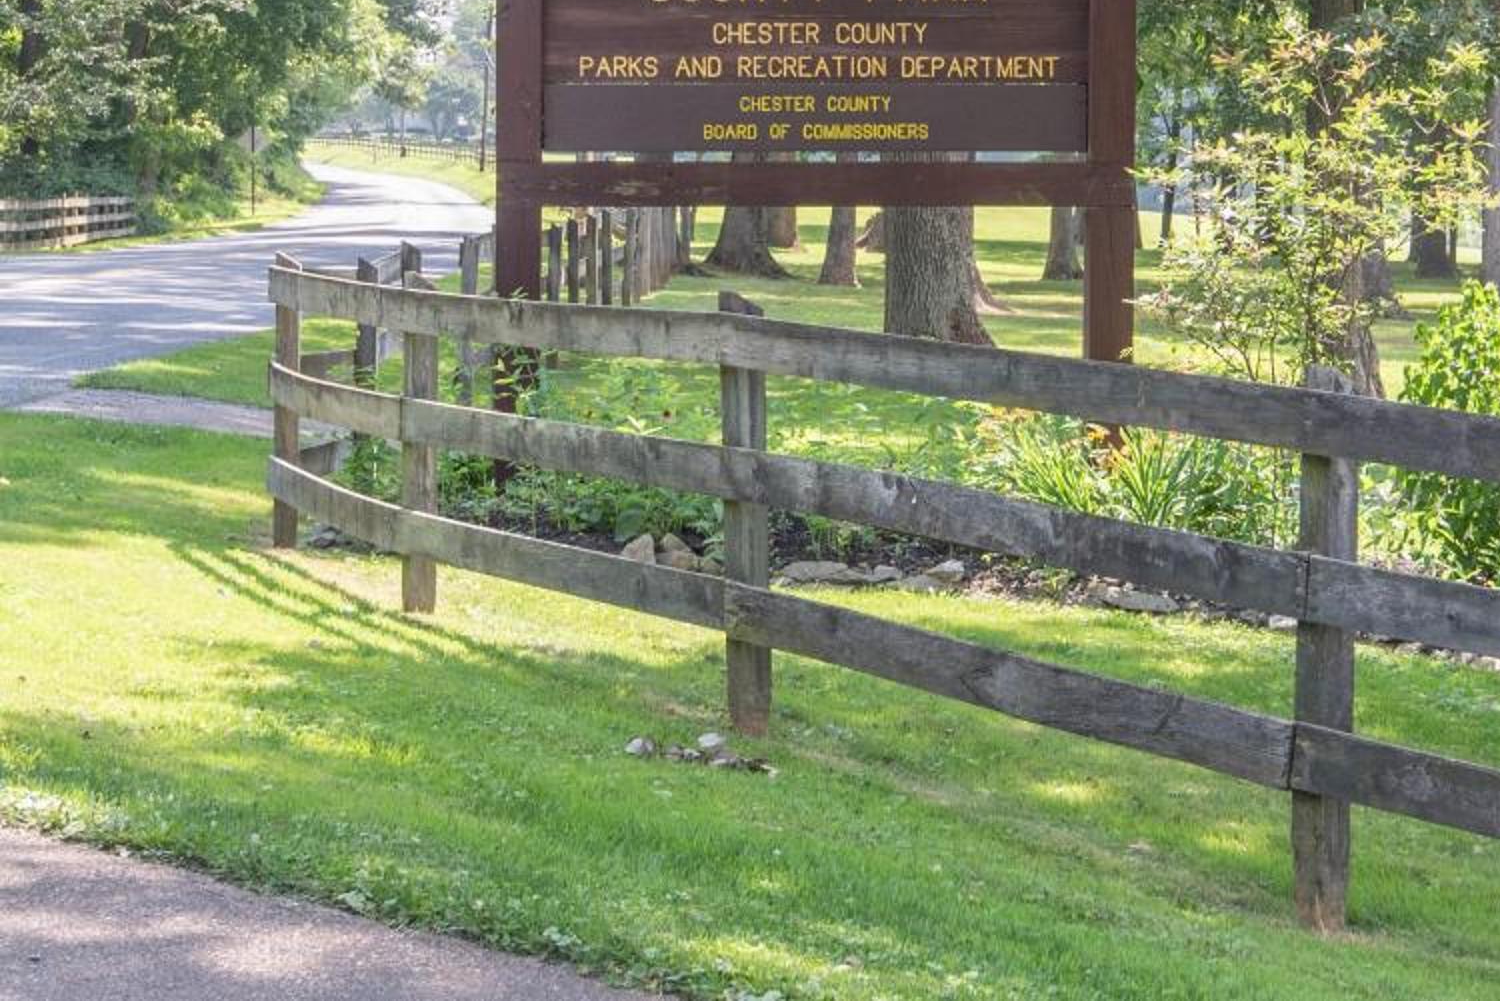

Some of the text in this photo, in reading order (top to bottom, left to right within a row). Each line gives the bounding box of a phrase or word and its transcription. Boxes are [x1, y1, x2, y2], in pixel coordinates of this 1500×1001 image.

[712, 22, 929, 44] CHESTER COUNTY
[578, 55, 1060, 79] PARKS AND RECREATION DEPARTMENT
[738, 95, 892, 114] CHESTER COUNTY
[703, 123, 930, 141] BOARD OF COMMISSIONERS
